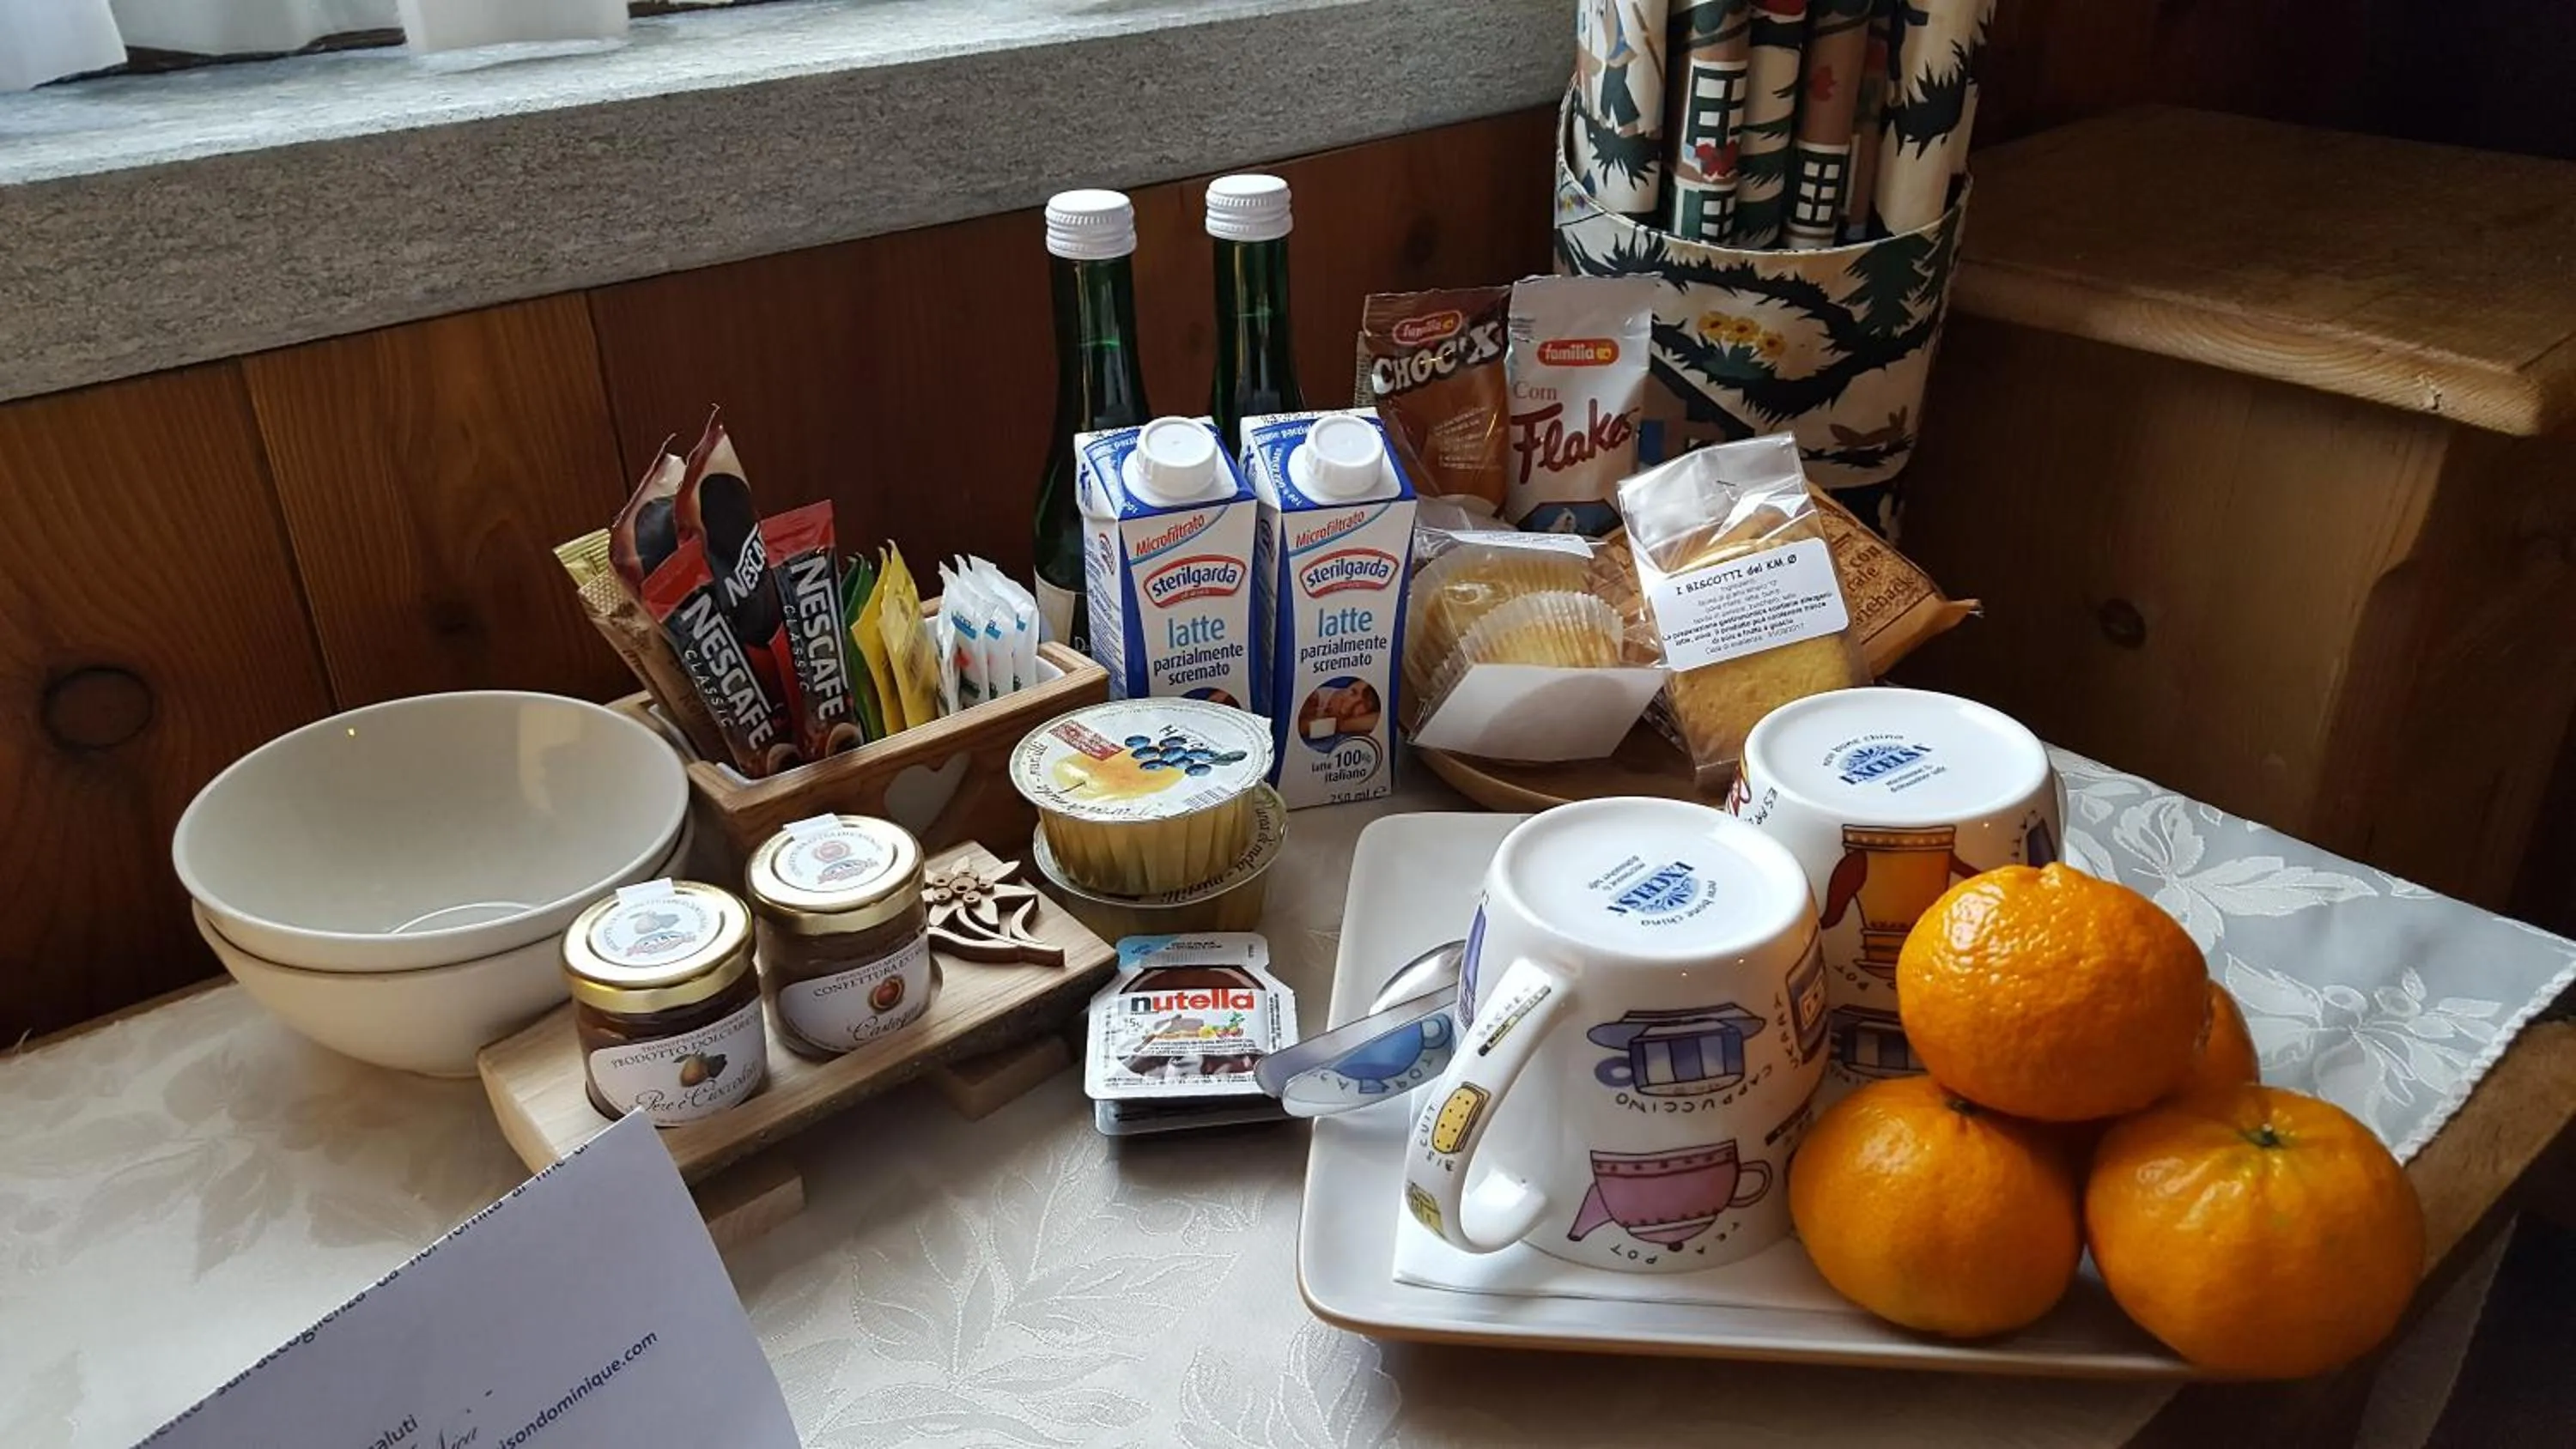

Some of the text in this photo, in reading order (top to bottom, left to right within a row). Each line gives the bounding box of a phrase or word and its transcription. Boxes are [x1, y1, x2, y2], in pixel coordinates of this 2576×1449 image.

[1401, 317, 1444, 339] familia
[1546, 343, 1595, 361] familia
[1514, 380, 1557, 401] Corn
[1136, 514, 1206, 556] Microfiltrato
[1295, 509, 1366, 549] Microfiltrato
[1307, 552, 1390, 589] sterilgarda
[1850, 544, 1882, 568] con
[1151, 558, 1238, 597] sterilgarda
[1685, 568, 1743, 592] BISCOTTI
[1745, 562, 1763, 575] del
[1765, 557, 1784, 570] KM
[1168, 617, 1225, 648] latte
[1318, 607, 1374, 638] latte
[783, 604, 810, 692] CLASSIC
[1153, 642, 1244, 676] parzialmente
[1300, 634, 1388, 664] parzialmente
[1312, 652, 1373, 675] scremato
[684, 649, 734, 729] CLASSIC
[1168, 664, 1230, 687] scremato
[1324, 768, 1367, 783] italiano
[1130, 988, 1255, 1013] nutella
[1616, 1064, 1773, 1114] CAPPUCCINO
